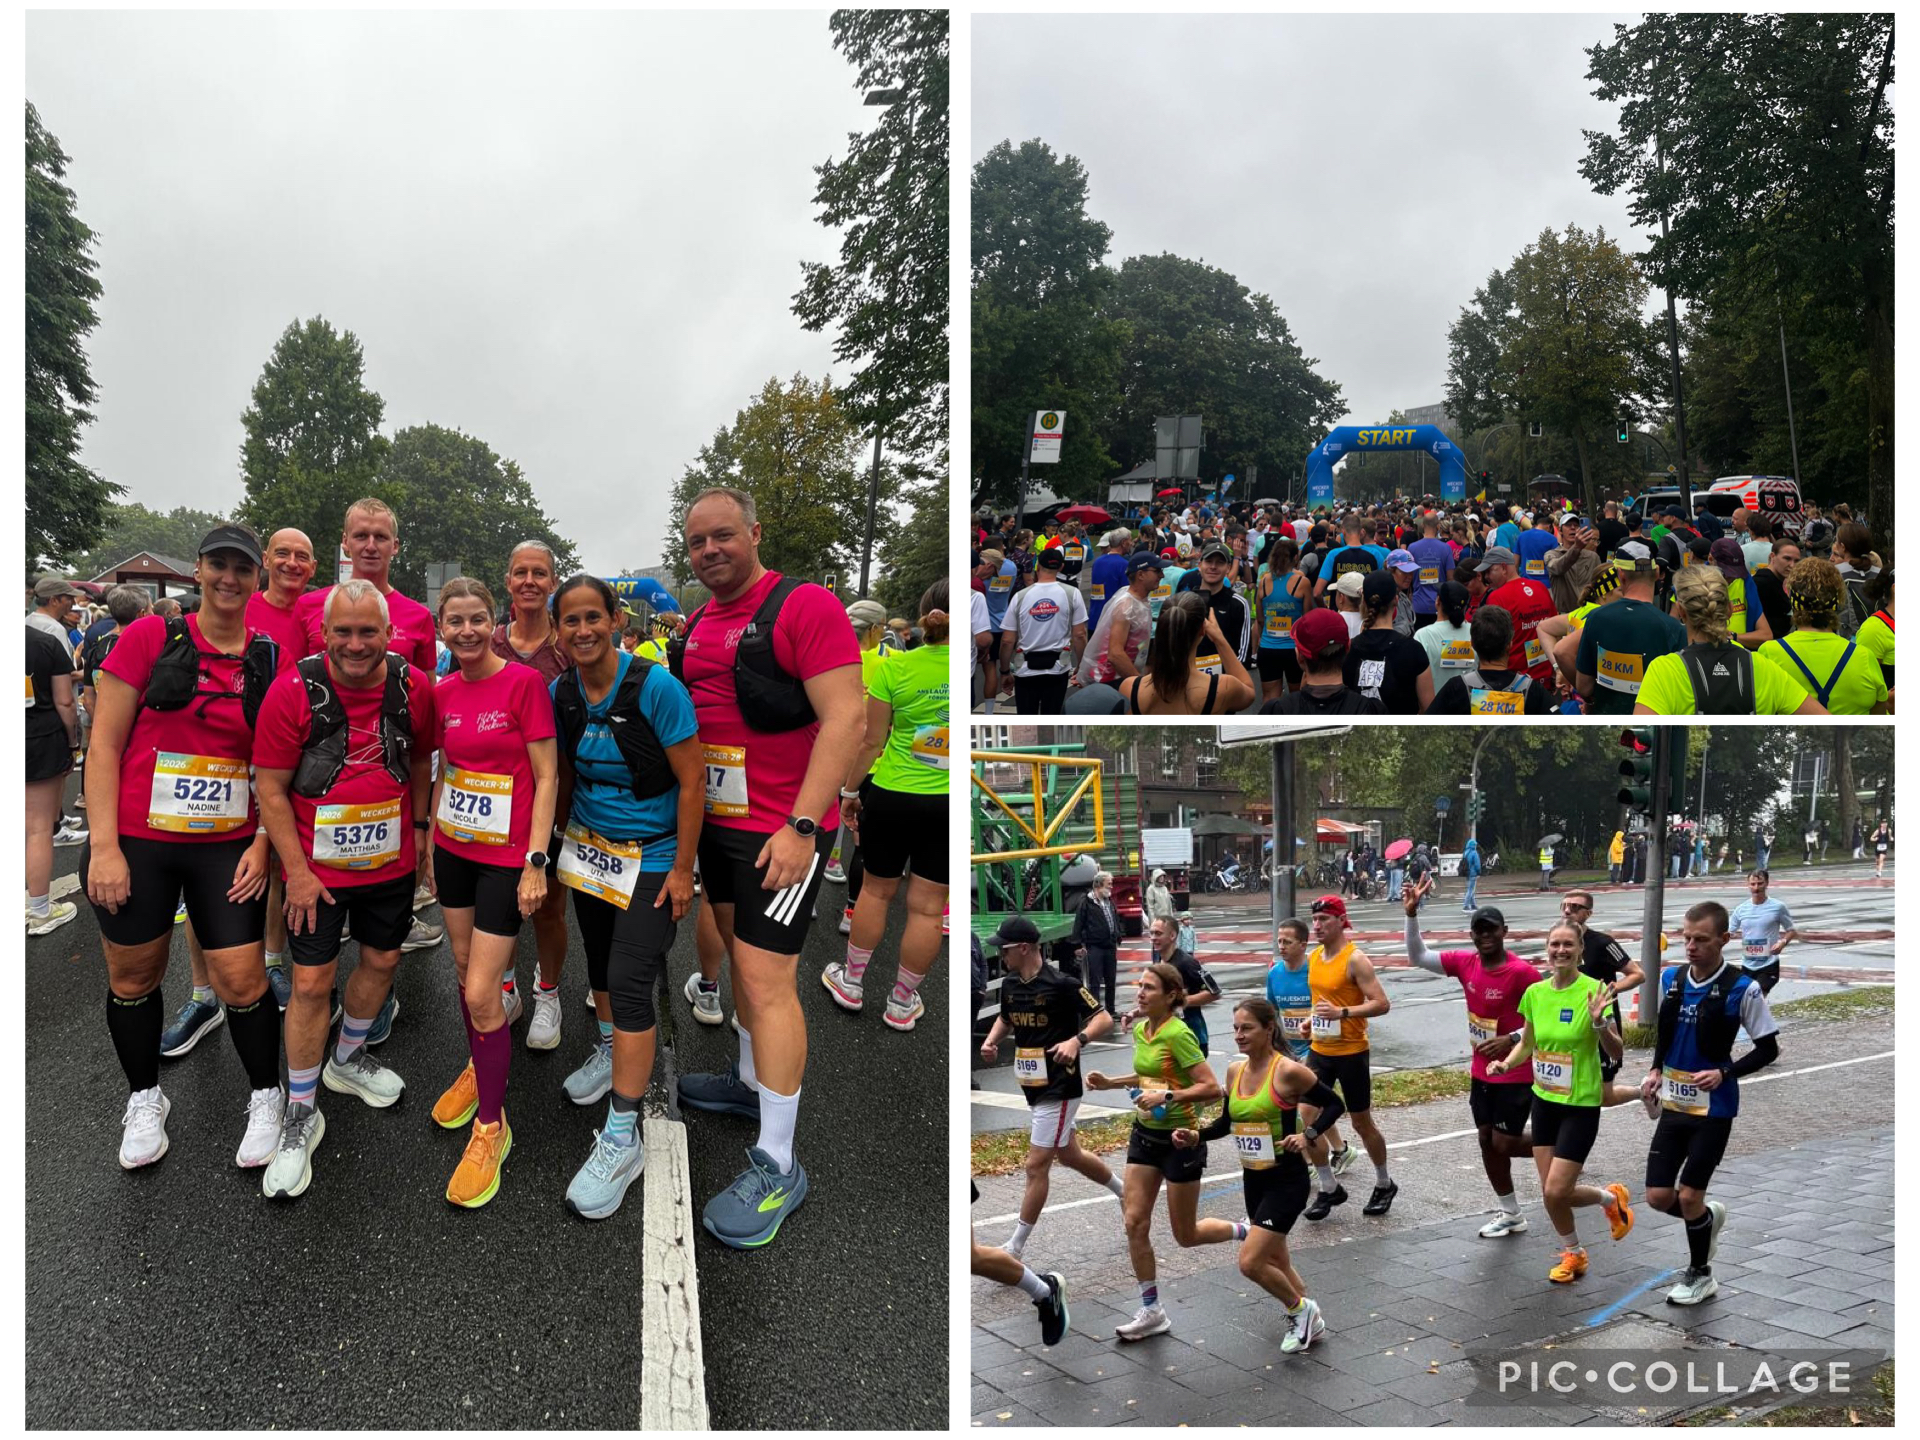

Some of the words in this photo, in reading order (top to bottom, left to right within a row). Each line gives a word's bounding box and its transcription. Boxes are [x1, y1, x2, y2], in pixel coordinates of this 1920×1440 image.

[1357, 429, 1417, 446] START
[1336, 563, 1372, 573] LISBOA
[1457, 647, 1471, 655] KM
[1531, 646, 1539, 655] 28
[1601, 658, 1612, 670] 28
[1614, 662, 1634, 675] KM
[1479, 700, 1495, 712] 28
[1496, 702, 1516, 714] KM
[924, 736, 945, 748] 28
[704, 751, 742, 761] ECKER-28
[163, 759, 187, 769] 2026
[706, 766, 726, 787] 17
[174, 778, 232, 801] 5221
[464, 777, 511, 790] WECKER-28
[187, 803, 221, 811] NADINE
[449, 788, 493, 816] 5278
[322, 811, 342, 819] 2026
[360, 805, 400, 818] WECKER-28
[453, 813, 479, 824] NICOLE
[333, 821, 388, 845] 5376
[340, 843, 381, 853] MATTHIAS
[576, 842, 623, 875] 5258
[590, 867, 605, 878] UTA
[1017, 1060, 1037, 1070] 5169
[1536, 1061, 1561, 1077] 5120
[1669, 1080, 1698, 1096] 5165
[1236, 1136, 1261, 1150] 5129
